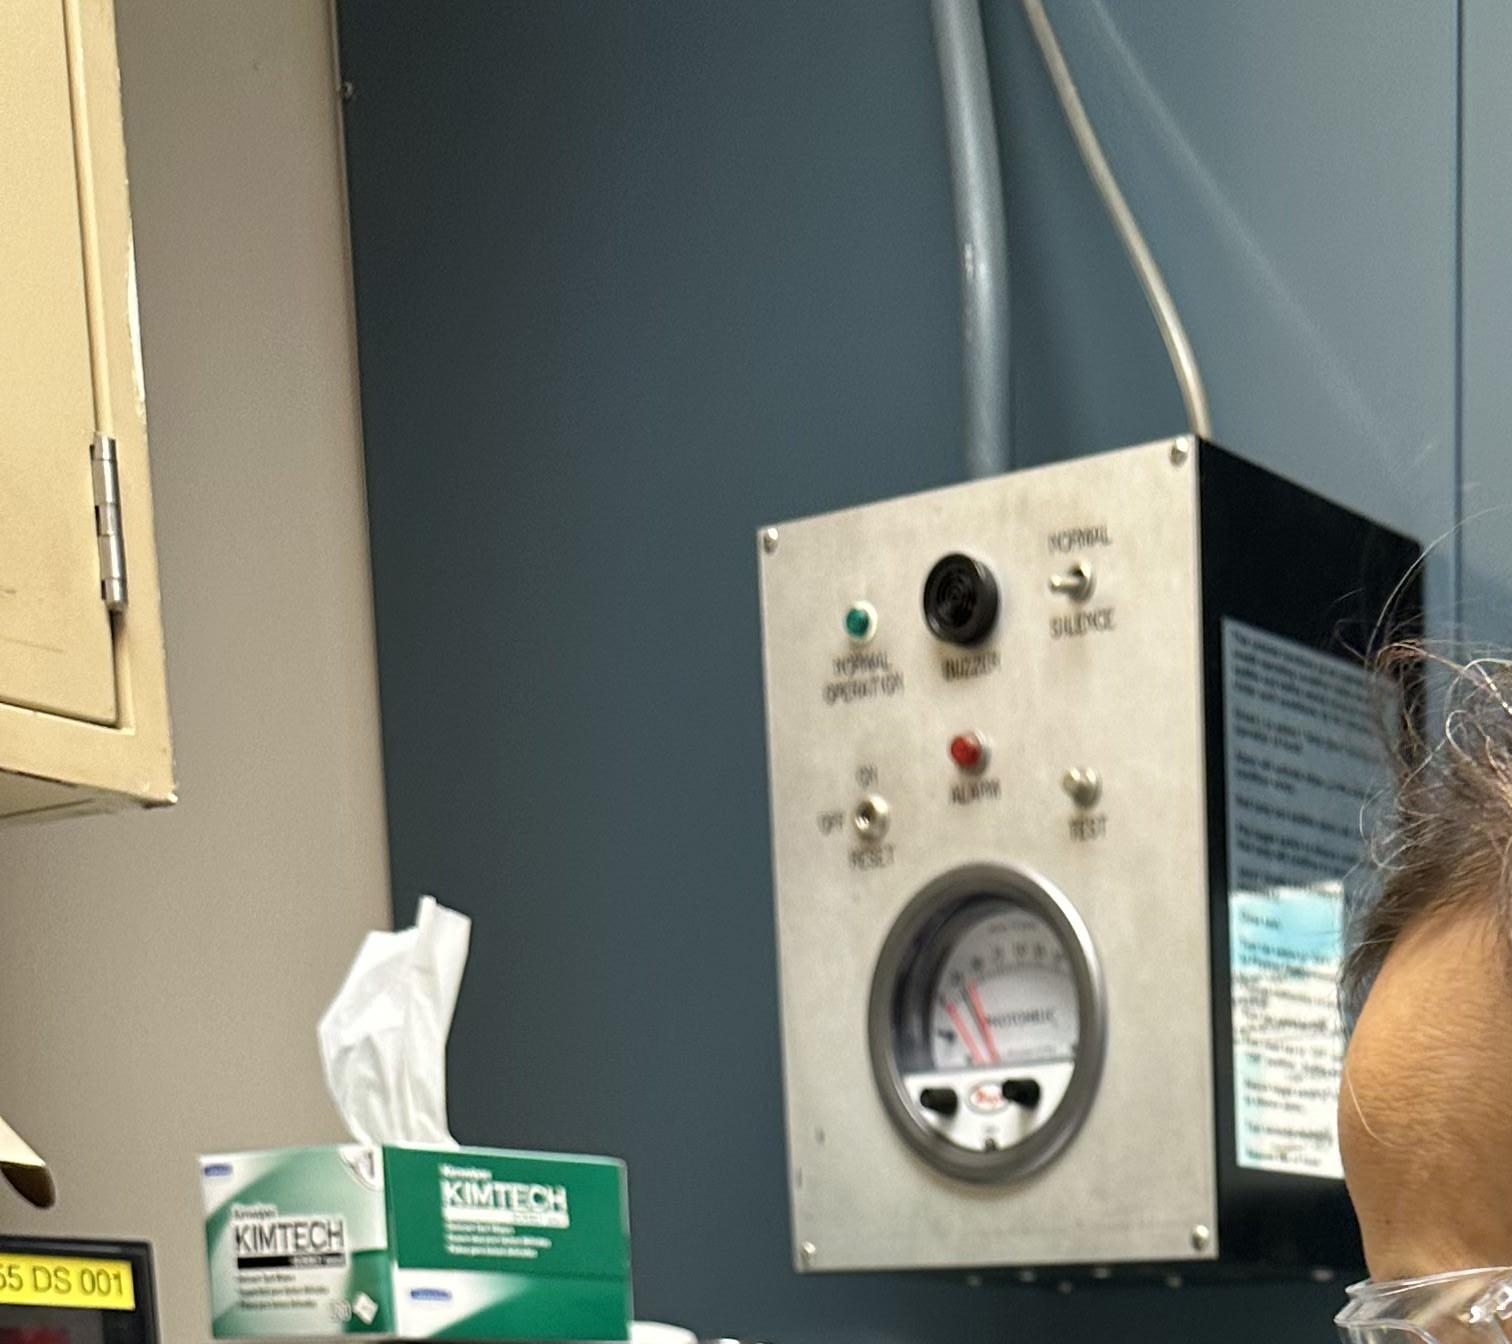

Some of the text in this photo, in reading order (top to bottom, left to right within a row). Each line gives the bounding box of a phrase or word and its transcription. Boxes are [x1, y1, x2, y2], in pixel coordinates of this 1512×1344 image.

[440, 1180, 567, 1213] KIMTECH
[234, 1219, 345, 1253] KIMTECH
[32, 1265, 73, 1295] DS
[79, 1268, 124, 1297] 001
